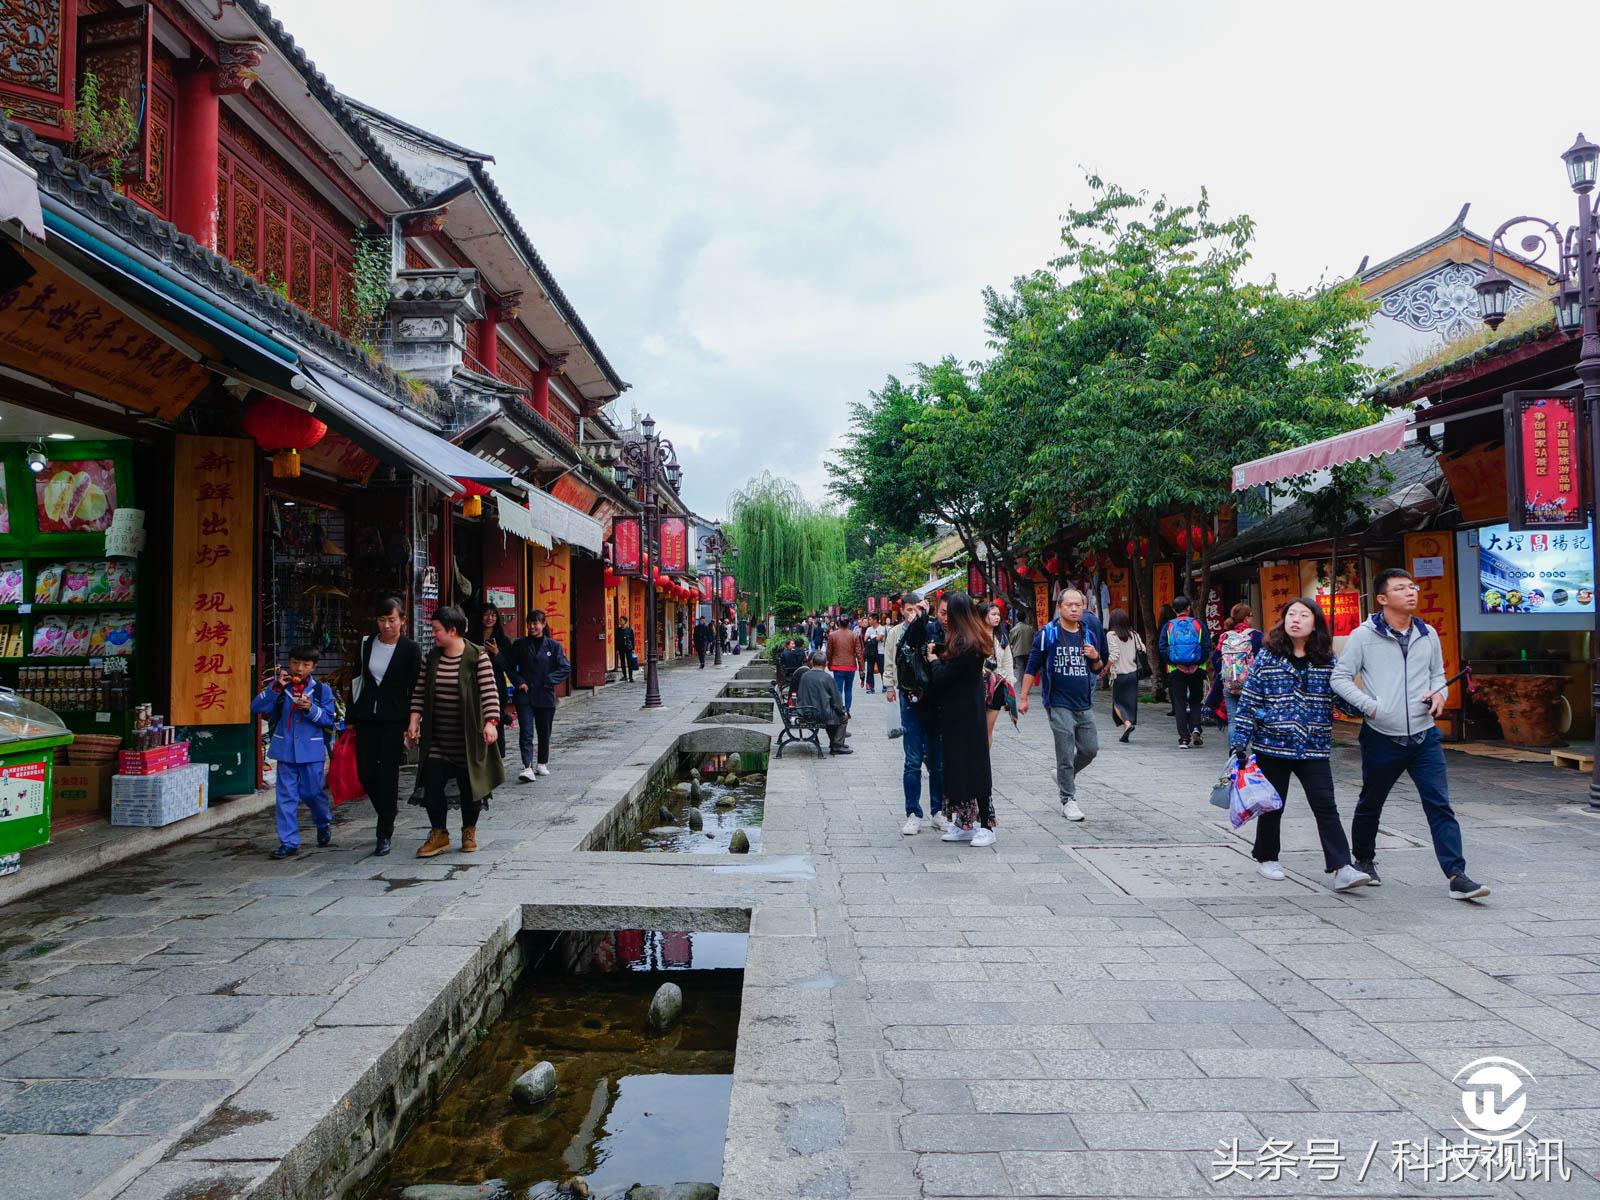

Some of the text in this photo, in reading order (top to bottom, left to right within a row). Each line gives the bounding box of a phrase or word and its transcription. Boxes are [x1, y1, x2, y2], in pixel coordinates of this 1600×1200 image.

[1533, 412, 1548, 475] 争创国家5A景区
[1556, 420, 1571, 492] 打造国际旅游品牌
[193, 451, 235, 711] 新鲜出炉 现烤现卖
[1063, 667, 1088, 677] LABEL
